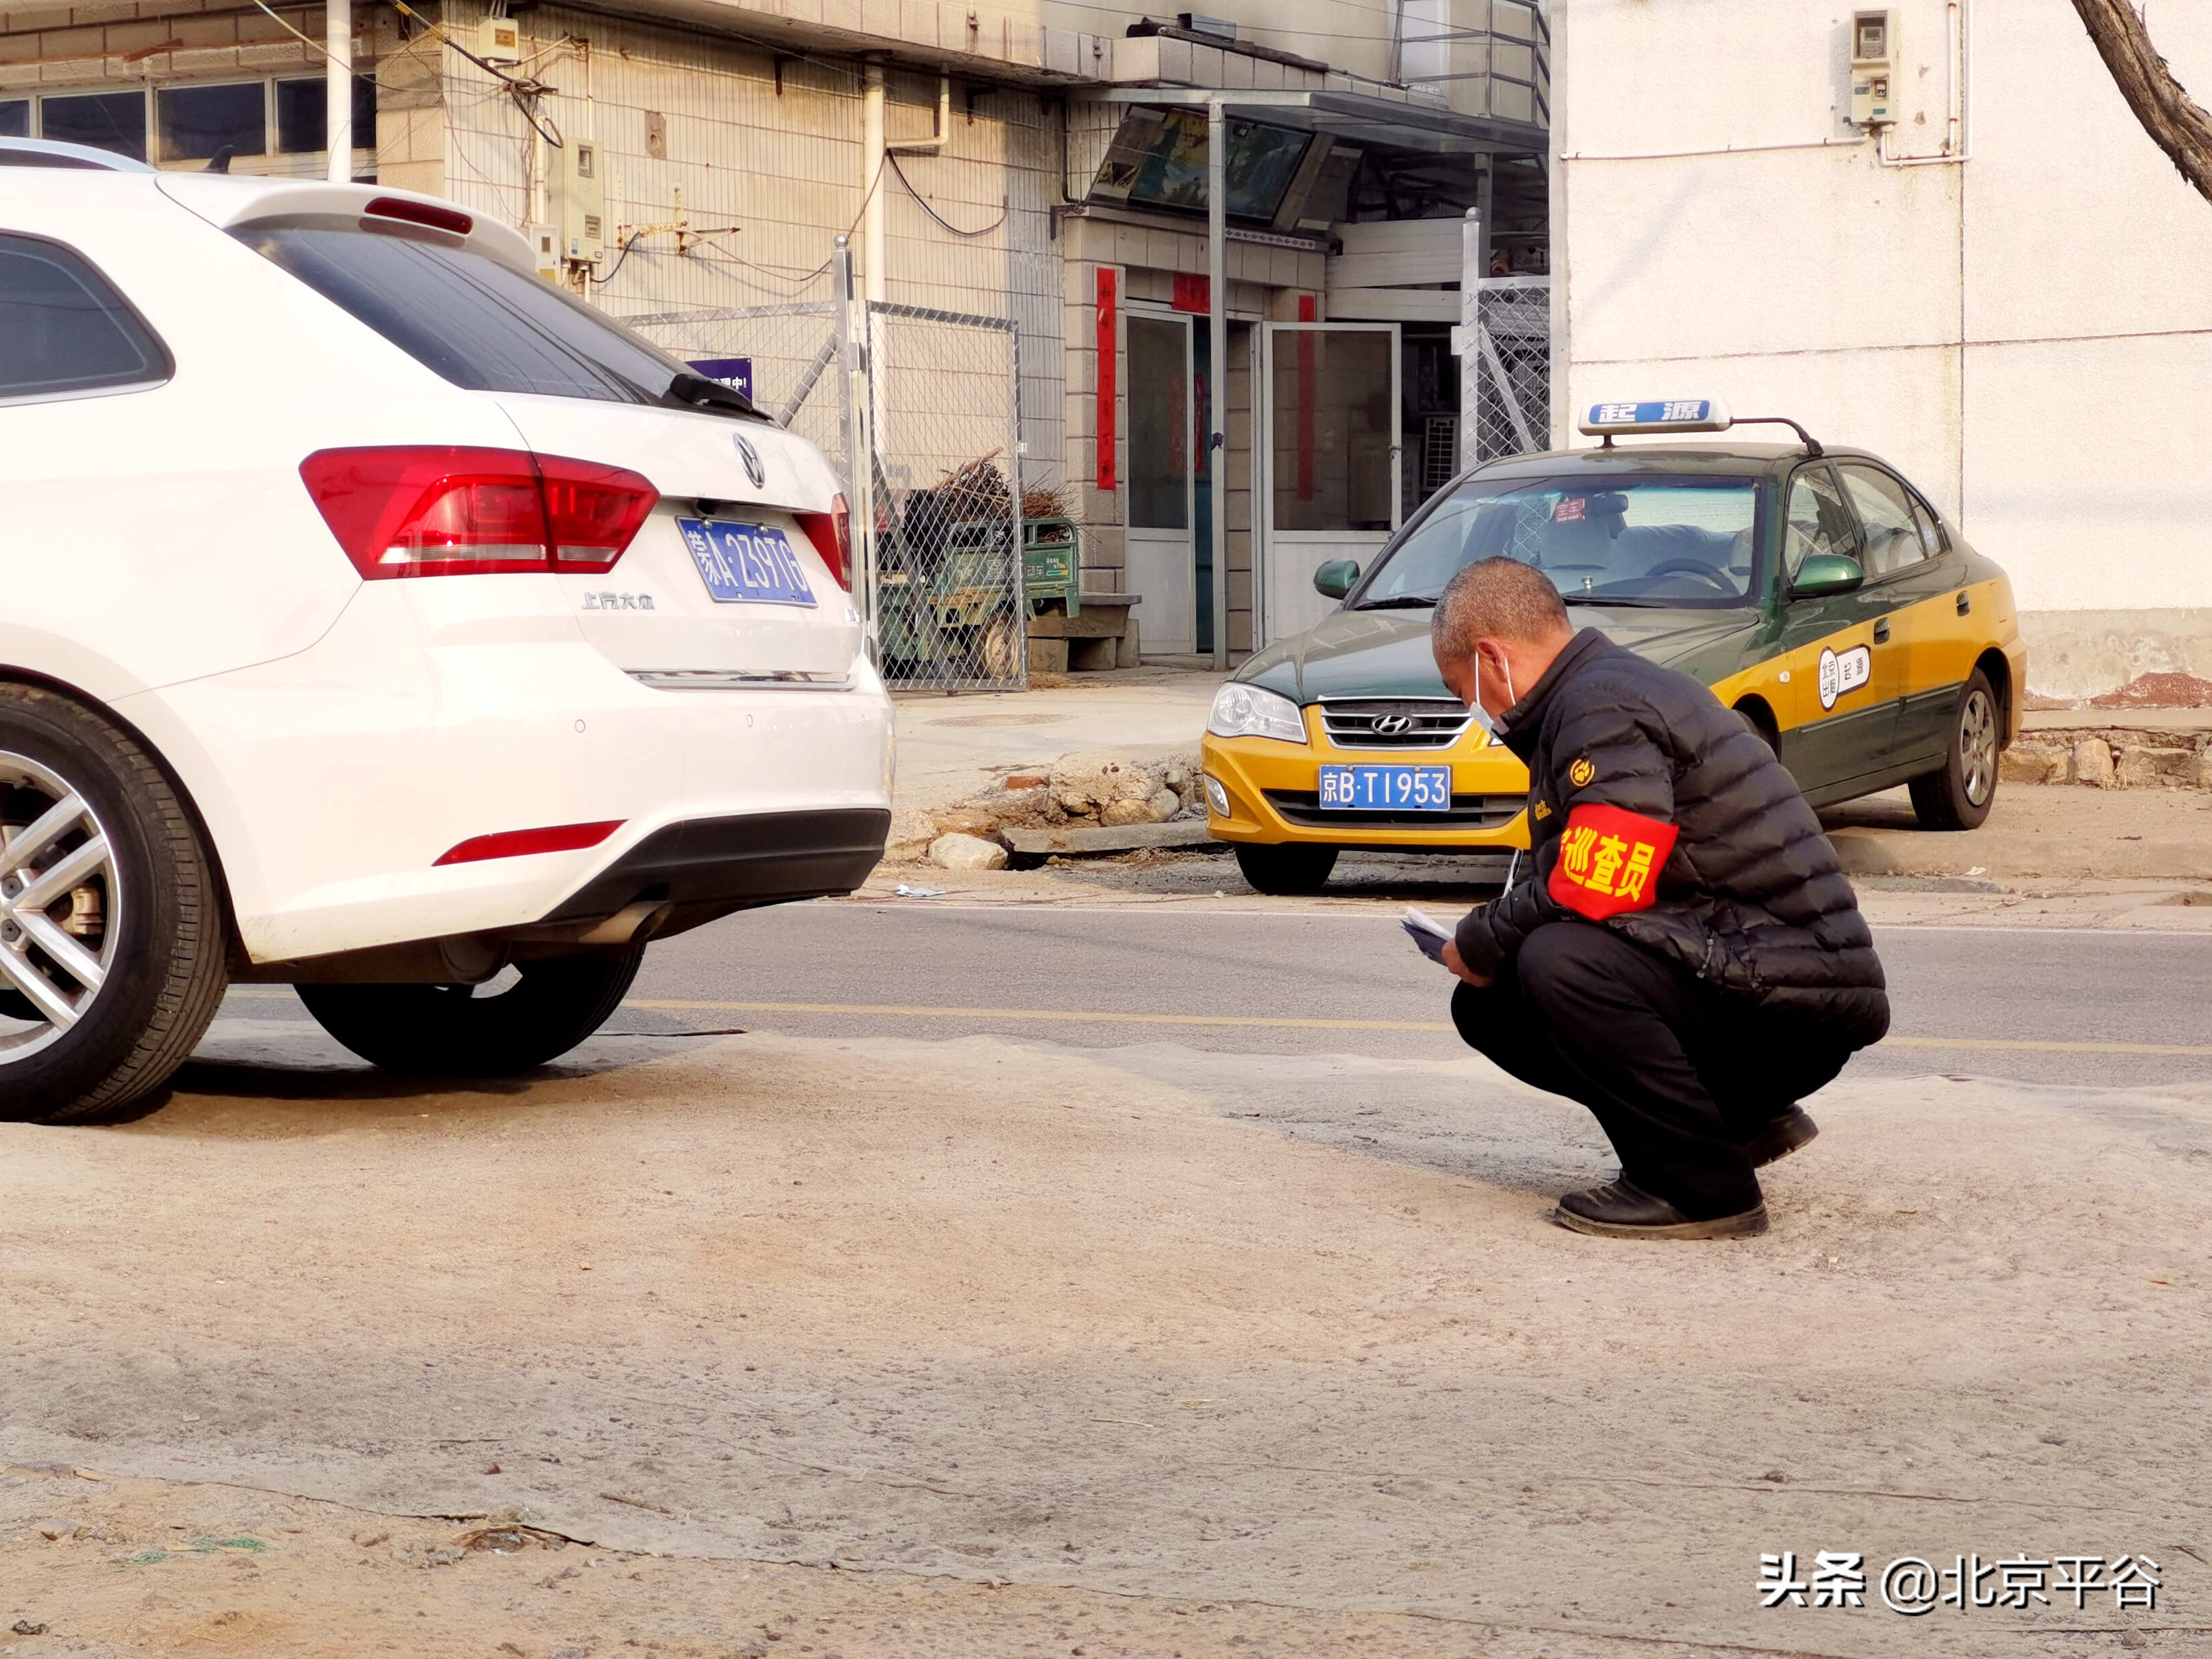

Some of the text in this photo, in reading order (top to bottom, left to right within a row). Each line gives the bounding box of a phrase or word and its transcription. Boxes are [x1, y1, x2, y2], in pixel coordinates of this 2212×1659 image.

[1599, 401, 1701, 422] 起源
[582, 591, 655, 610] 上汽大众
[1561, 826, 1655, 902] 巡查员
